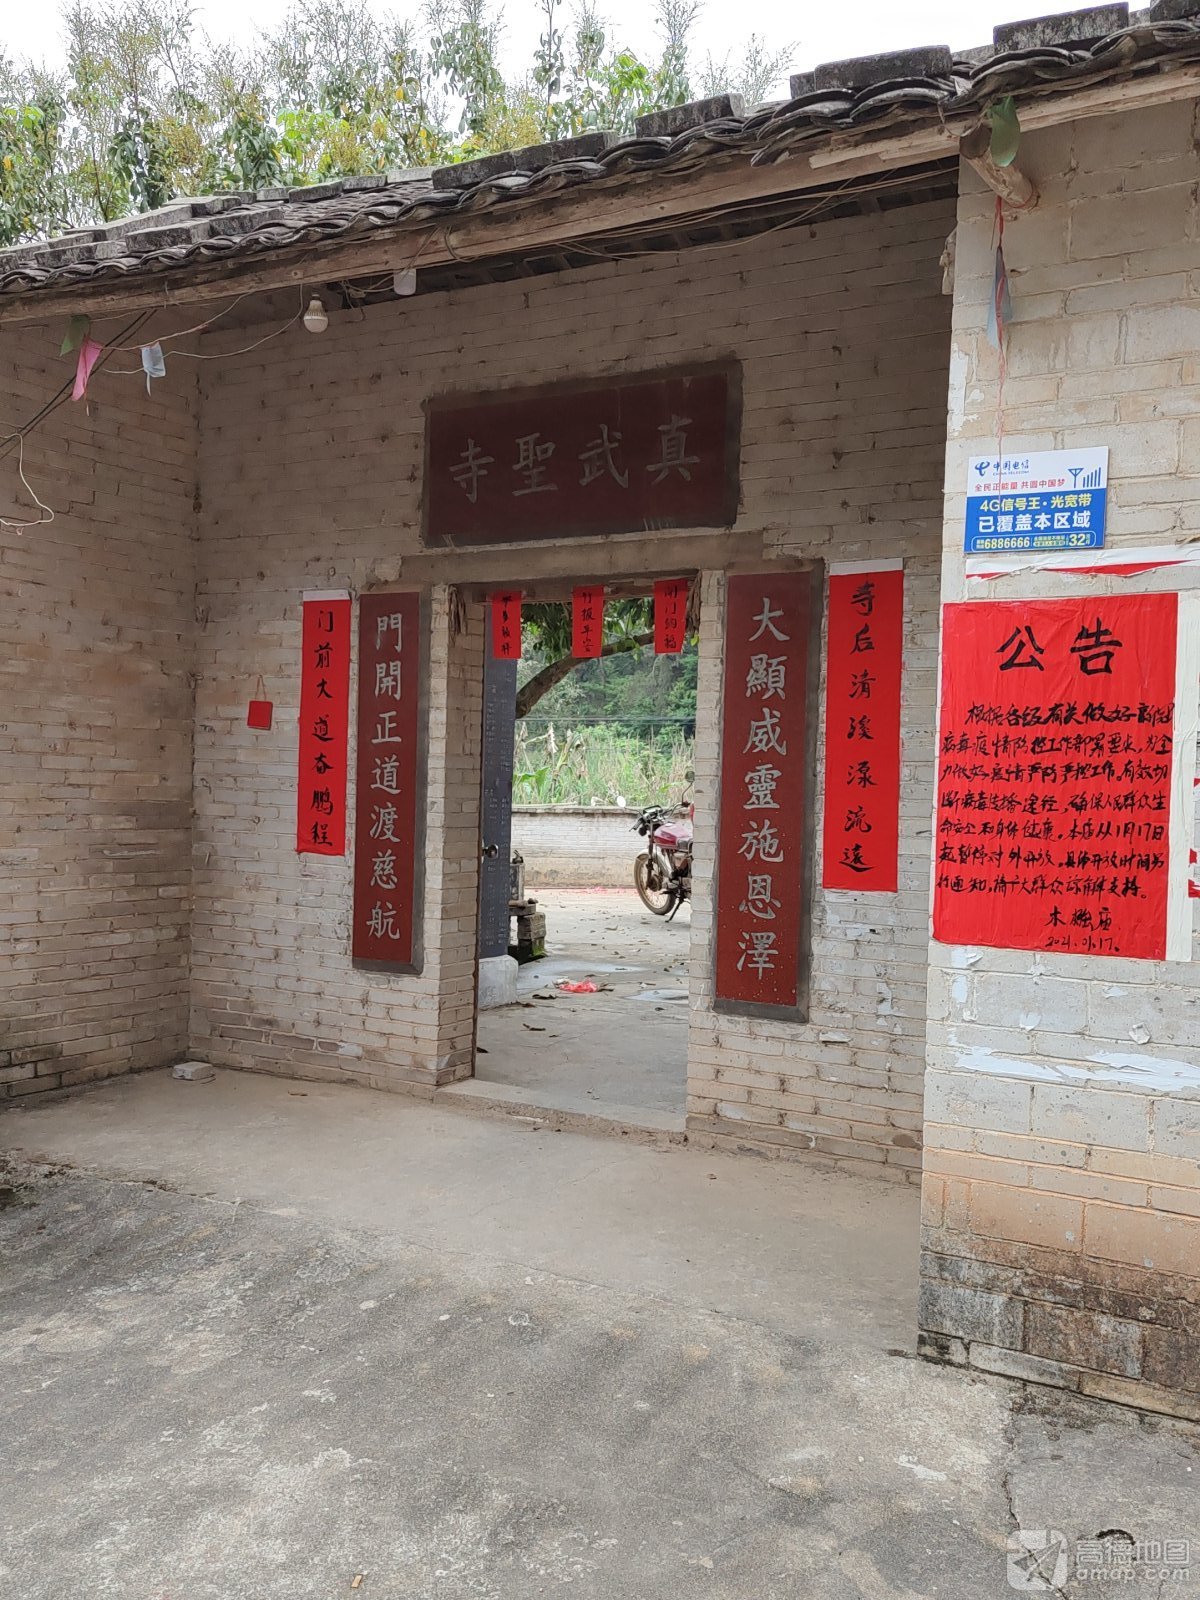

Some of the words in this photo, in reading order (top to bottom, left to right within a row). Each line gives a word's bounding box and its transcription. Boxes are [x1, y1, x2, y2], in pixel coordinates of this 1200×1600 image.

[975, 481, 1018, 493] 全民正能量
[978, 510, 1091, 533] 已覆盖本区域
[984, 537, 1030, 549] 6886666
[1069, 533, 1086, 547] 32
[996, 617, 1124, 676] 公告
[366, 611, 403, 941] 門開正道渡慈航
[736, 597, 791, 981] 大顯威靈施恩澤
